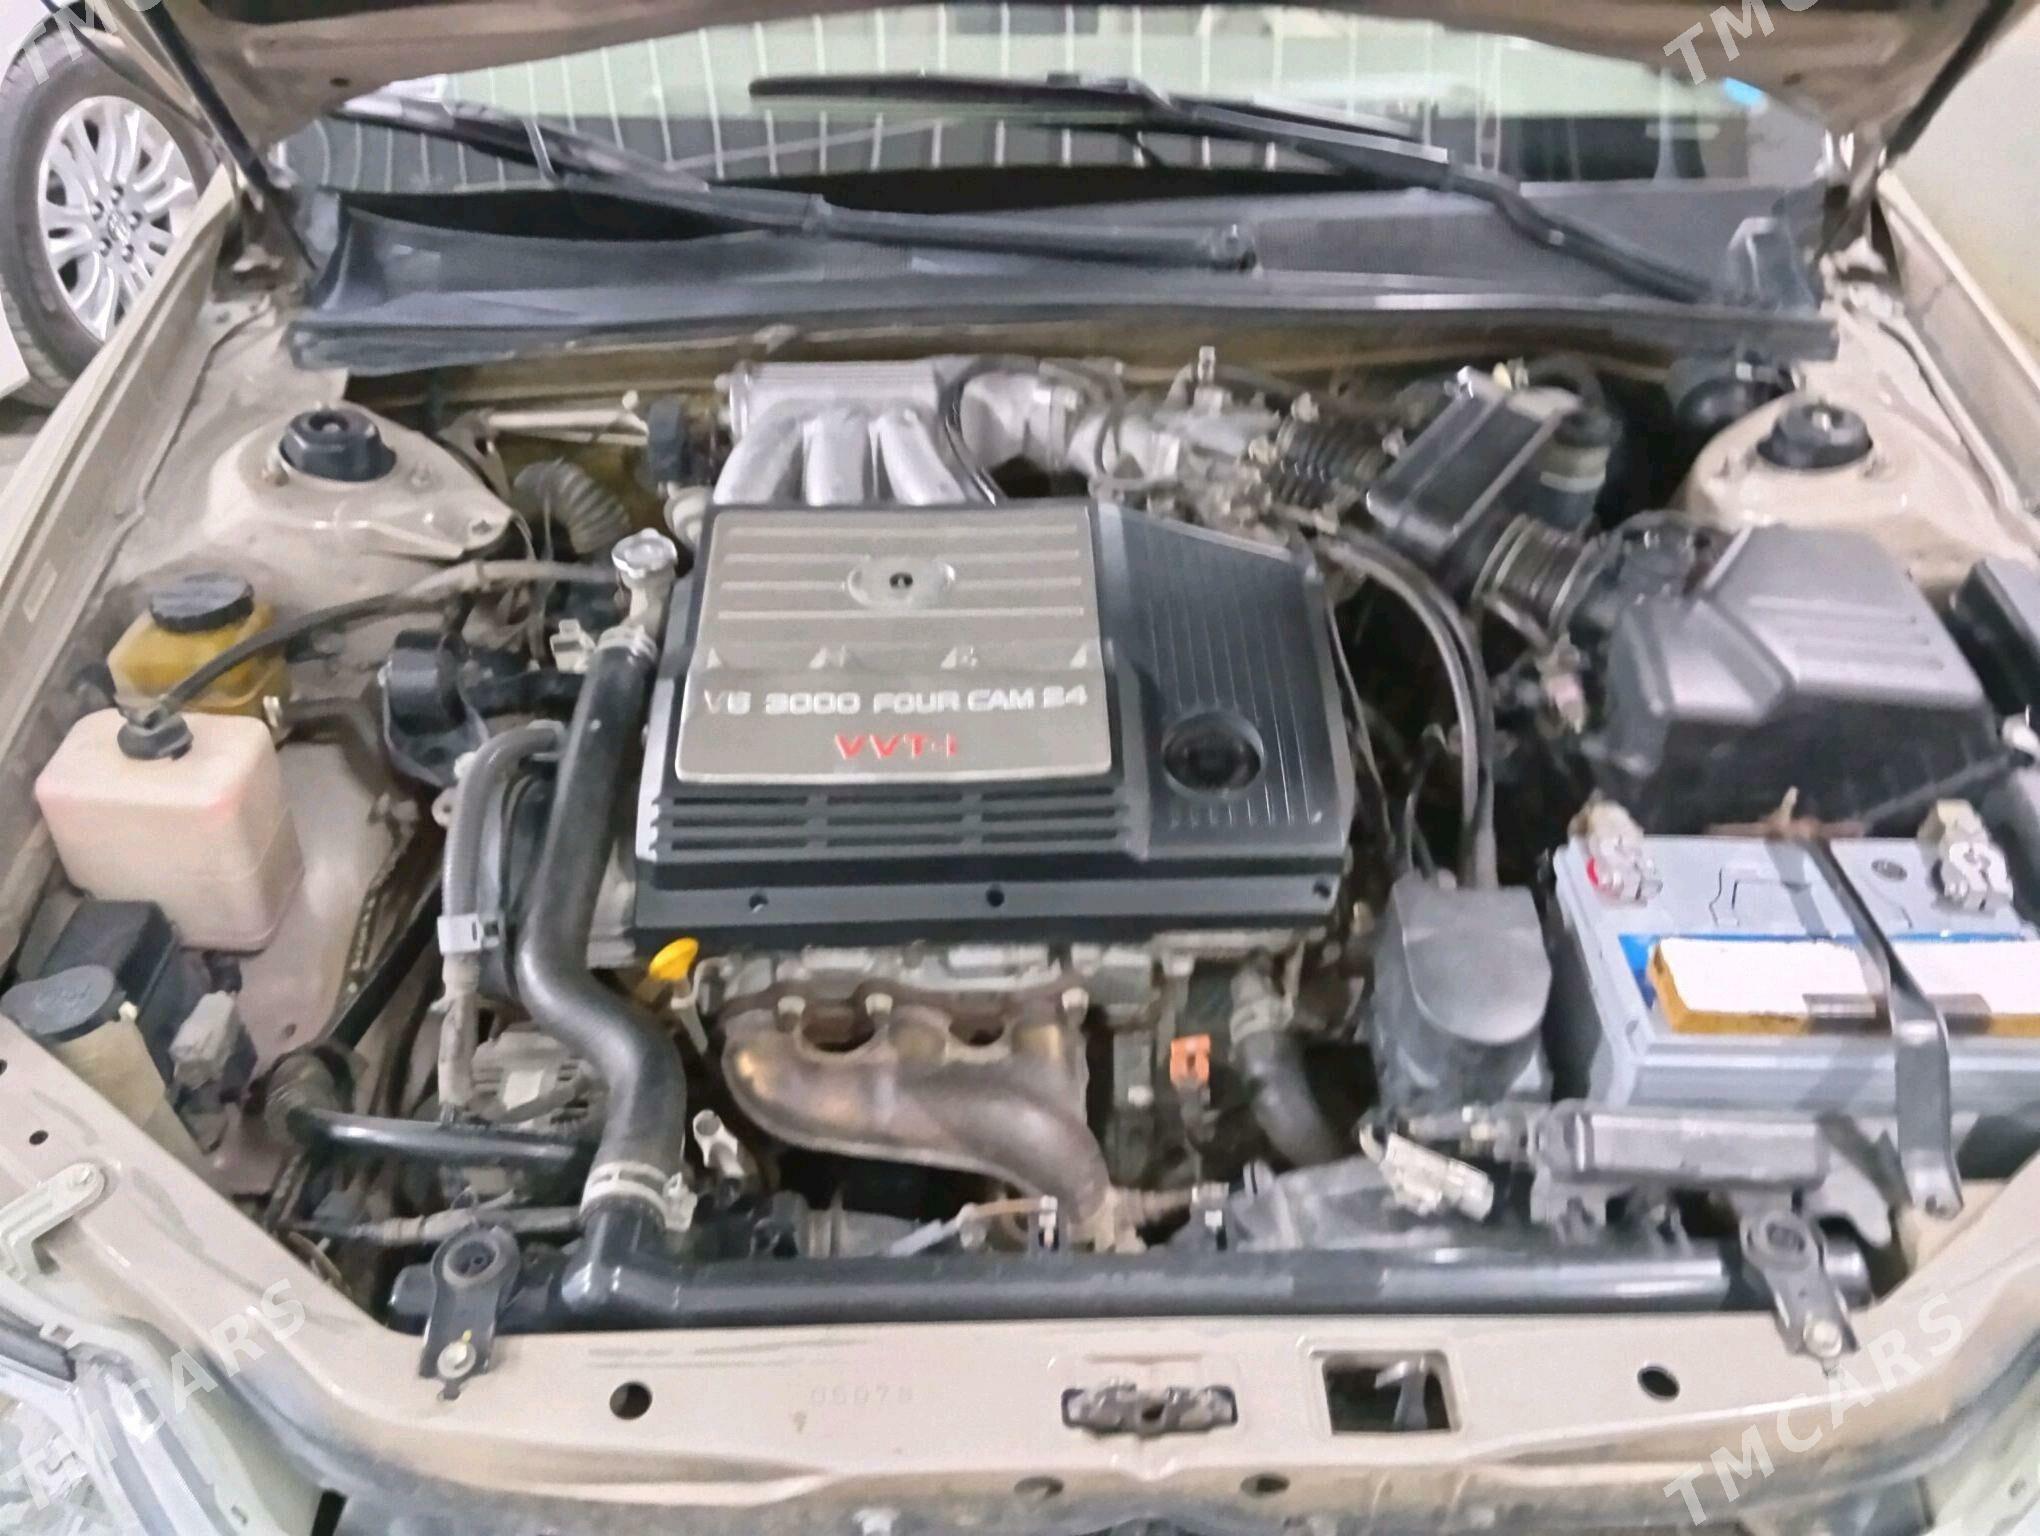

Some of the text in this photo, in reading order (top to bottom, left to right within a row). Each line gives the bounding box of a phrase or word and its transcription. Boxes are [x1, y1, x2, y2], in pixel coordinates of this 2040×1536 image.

[765, 691, 861, 715] 3000
[873, 689, 961, 715] FOUR
[967, 687, 1036, 712] CAM
